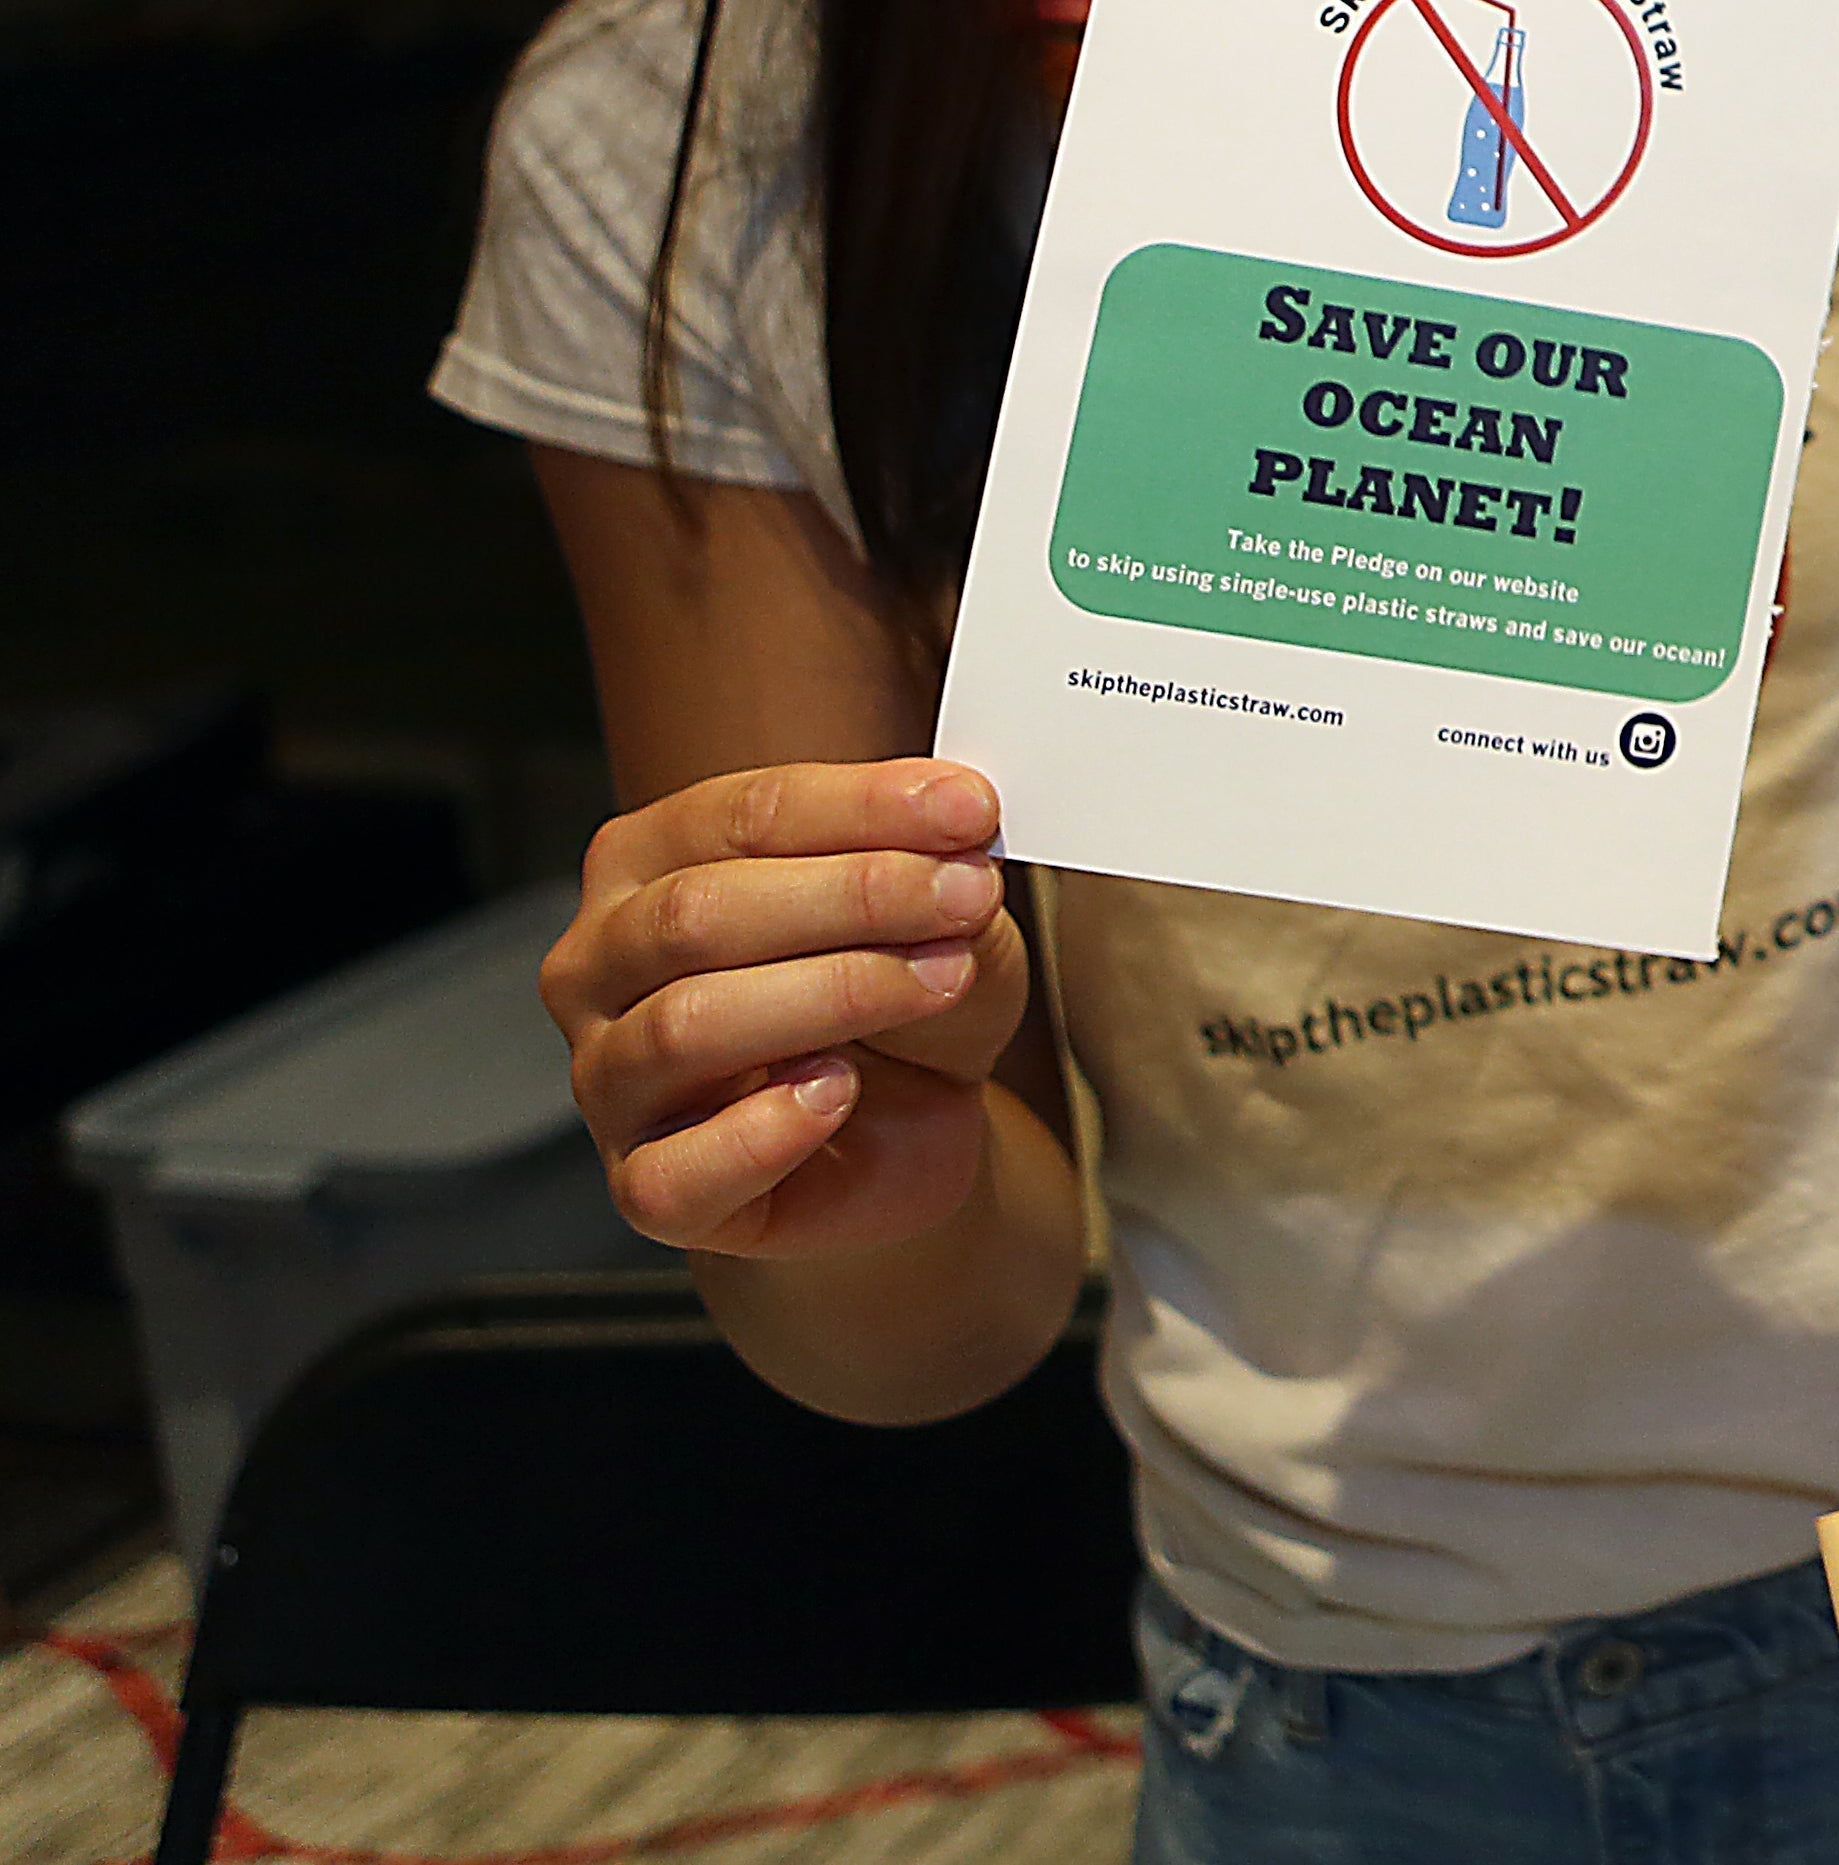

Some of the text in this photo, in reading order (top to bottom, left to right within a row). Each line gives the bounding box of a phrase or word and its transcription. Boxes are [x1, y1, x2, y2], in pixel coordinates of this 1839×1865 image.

[1259, 286, 1629, 398] SAVE OUR
[1302, 381, 1562, 465] OCEAN
[1248, 448, 1584, 544] PLANET!
[1227, 529, 1580, 603] Take the Pledge on our website
[1067, 547, 1726, 670] to skip using single-use plastic straws and save our ocean!
[1067, 667, 1344, 727] skiptheplasticstraw.com
[1438, 723, 1610, 766] connect with us
